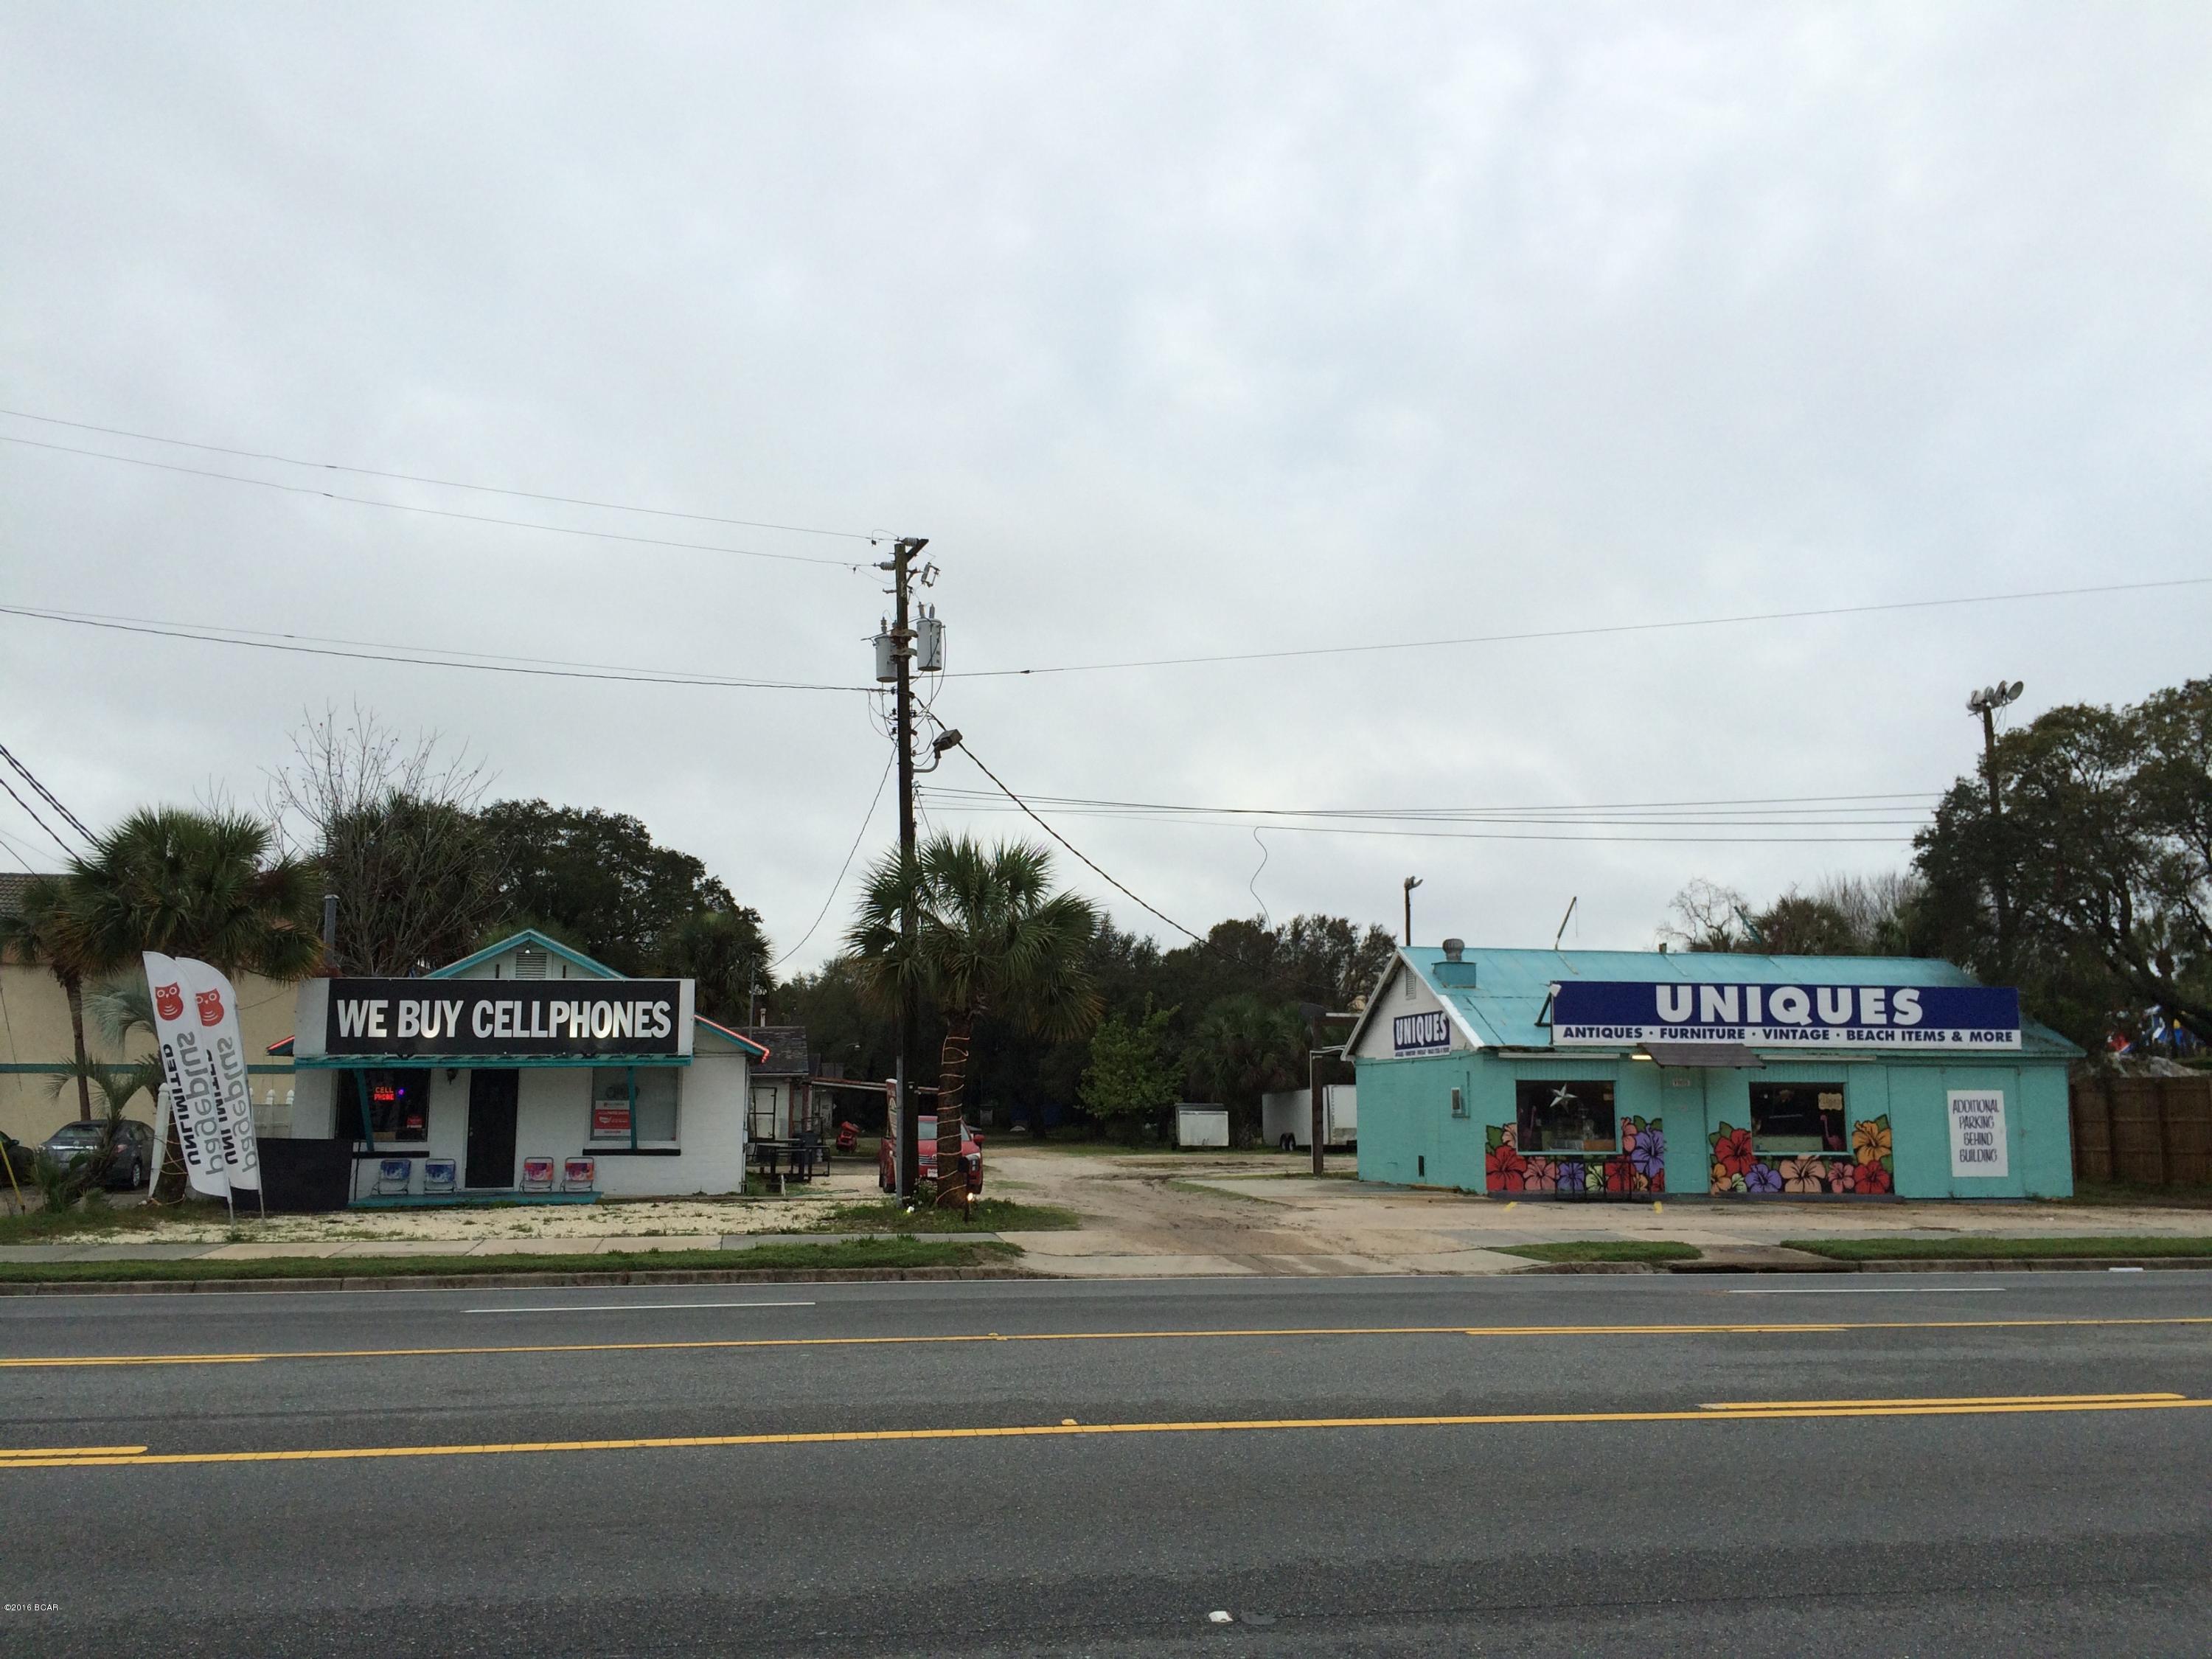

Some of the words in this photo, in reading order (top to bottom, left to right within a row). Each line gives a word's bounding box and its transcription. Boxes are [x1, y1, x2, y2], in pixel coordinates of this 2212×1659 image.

[1655, 985, 1923, 1026] UNIQUES
[337, 999, 389, 1037] WE
[397, 999, 464, 1038] BUY
[472, 1000, 672, 1038] CELLPHONES
[1396, 1013, 1447, 1046] UNIQUES
[1563, 1026, 1643, 1039] ANTIQUES
[1660, 1027, 1745, 1040] FURNITURE
[1762, 1029, 1830, 1040] VINTAGE
[1846, 1029, 1895, 1041] BEACH
[1901, 1030, 1945, 1042] ITEMS
[1951, 1031, 1963, 1043] &
[1969, 1031, 2013, 1043] MORE
[1952, 1099, 2000, 1114] ADDITIONAL
[1959, 1116, 1994, 1130] PARKING
[1964, 1132, 1993, 1146] BEHIND
[1959, 1149, 1997, 1163] BUILDING
